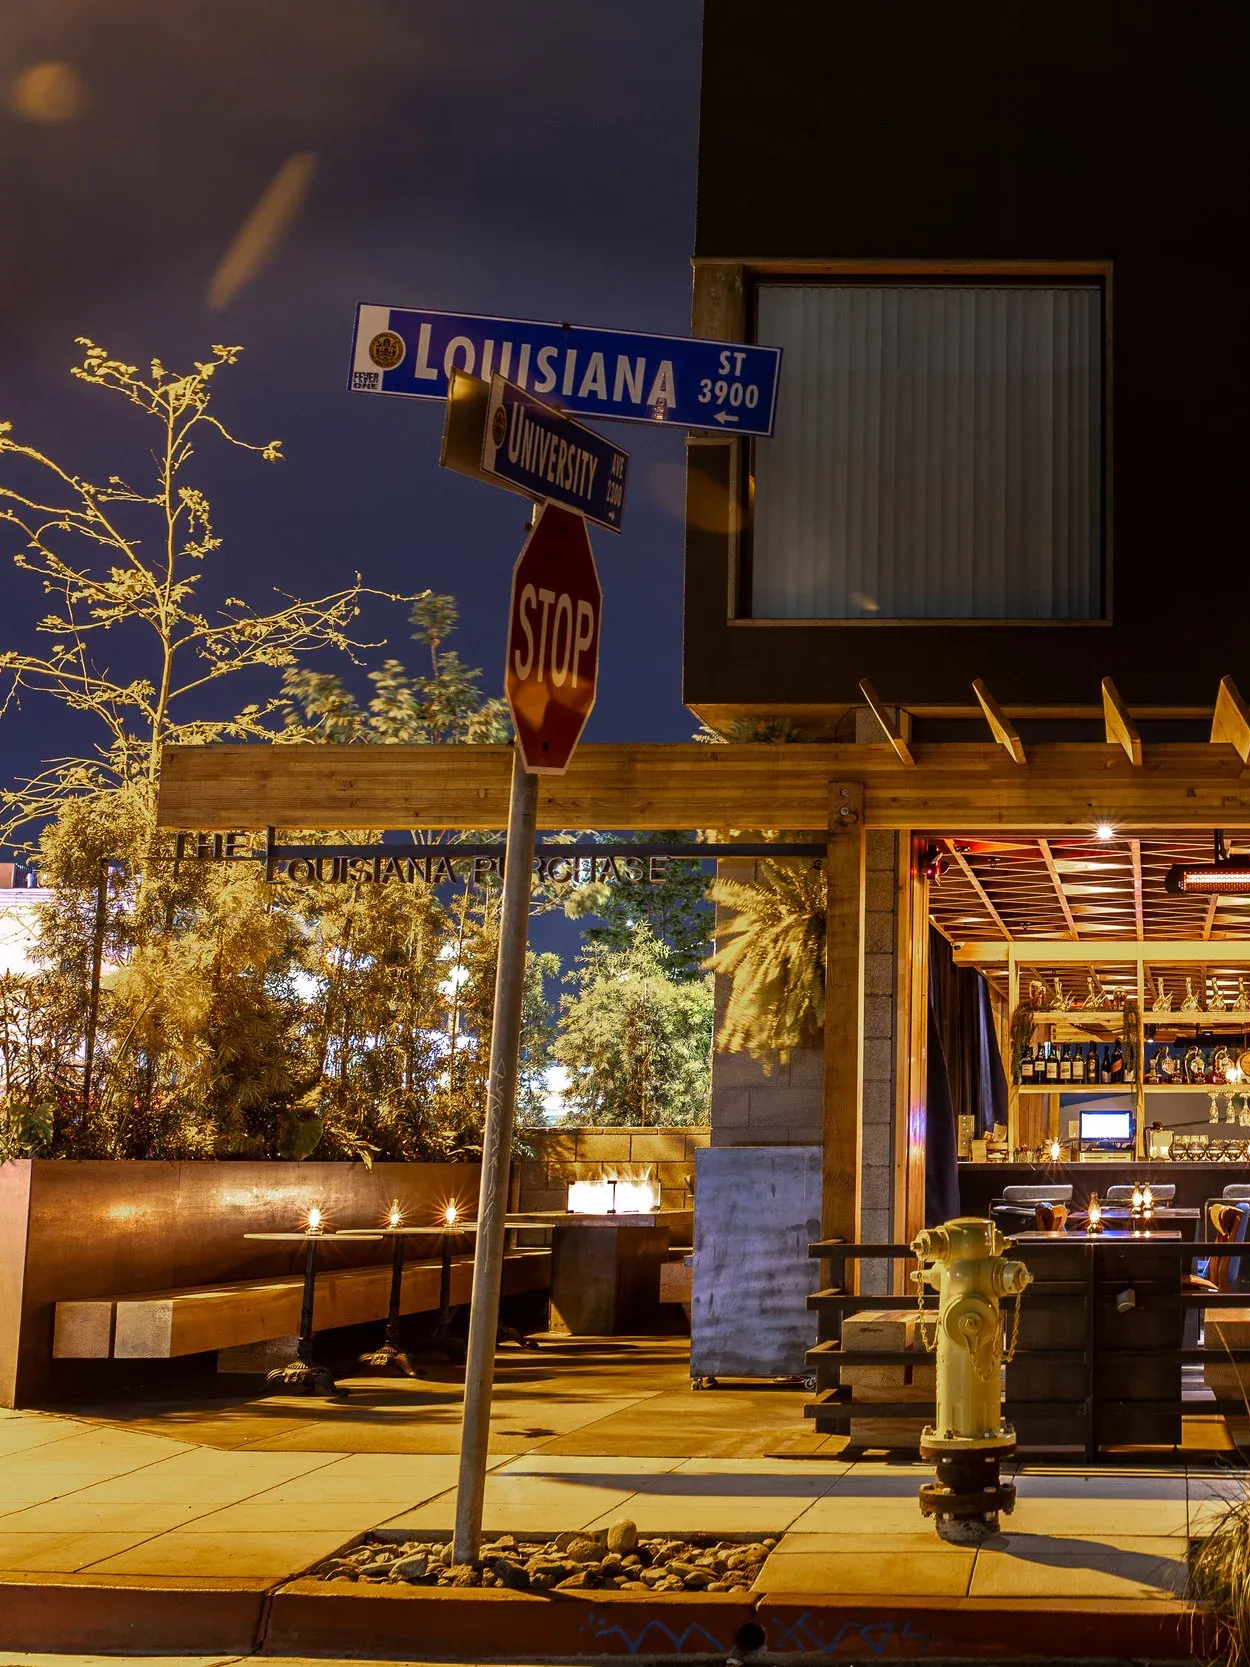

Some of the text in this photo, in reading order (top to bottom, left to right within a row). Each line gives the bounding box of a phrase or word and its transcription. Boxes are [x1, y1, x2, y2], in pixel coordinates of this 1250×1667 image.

[414, 322, 677, 409] LOUISIANA
[718, 350, 747, 377] ST
[698, 379, 760, 409] 3900
[507, 401, 599, 500] UNIVERSITY
[514, 583, 595, 689] STOP
[171, 831, 249, 858] THE
